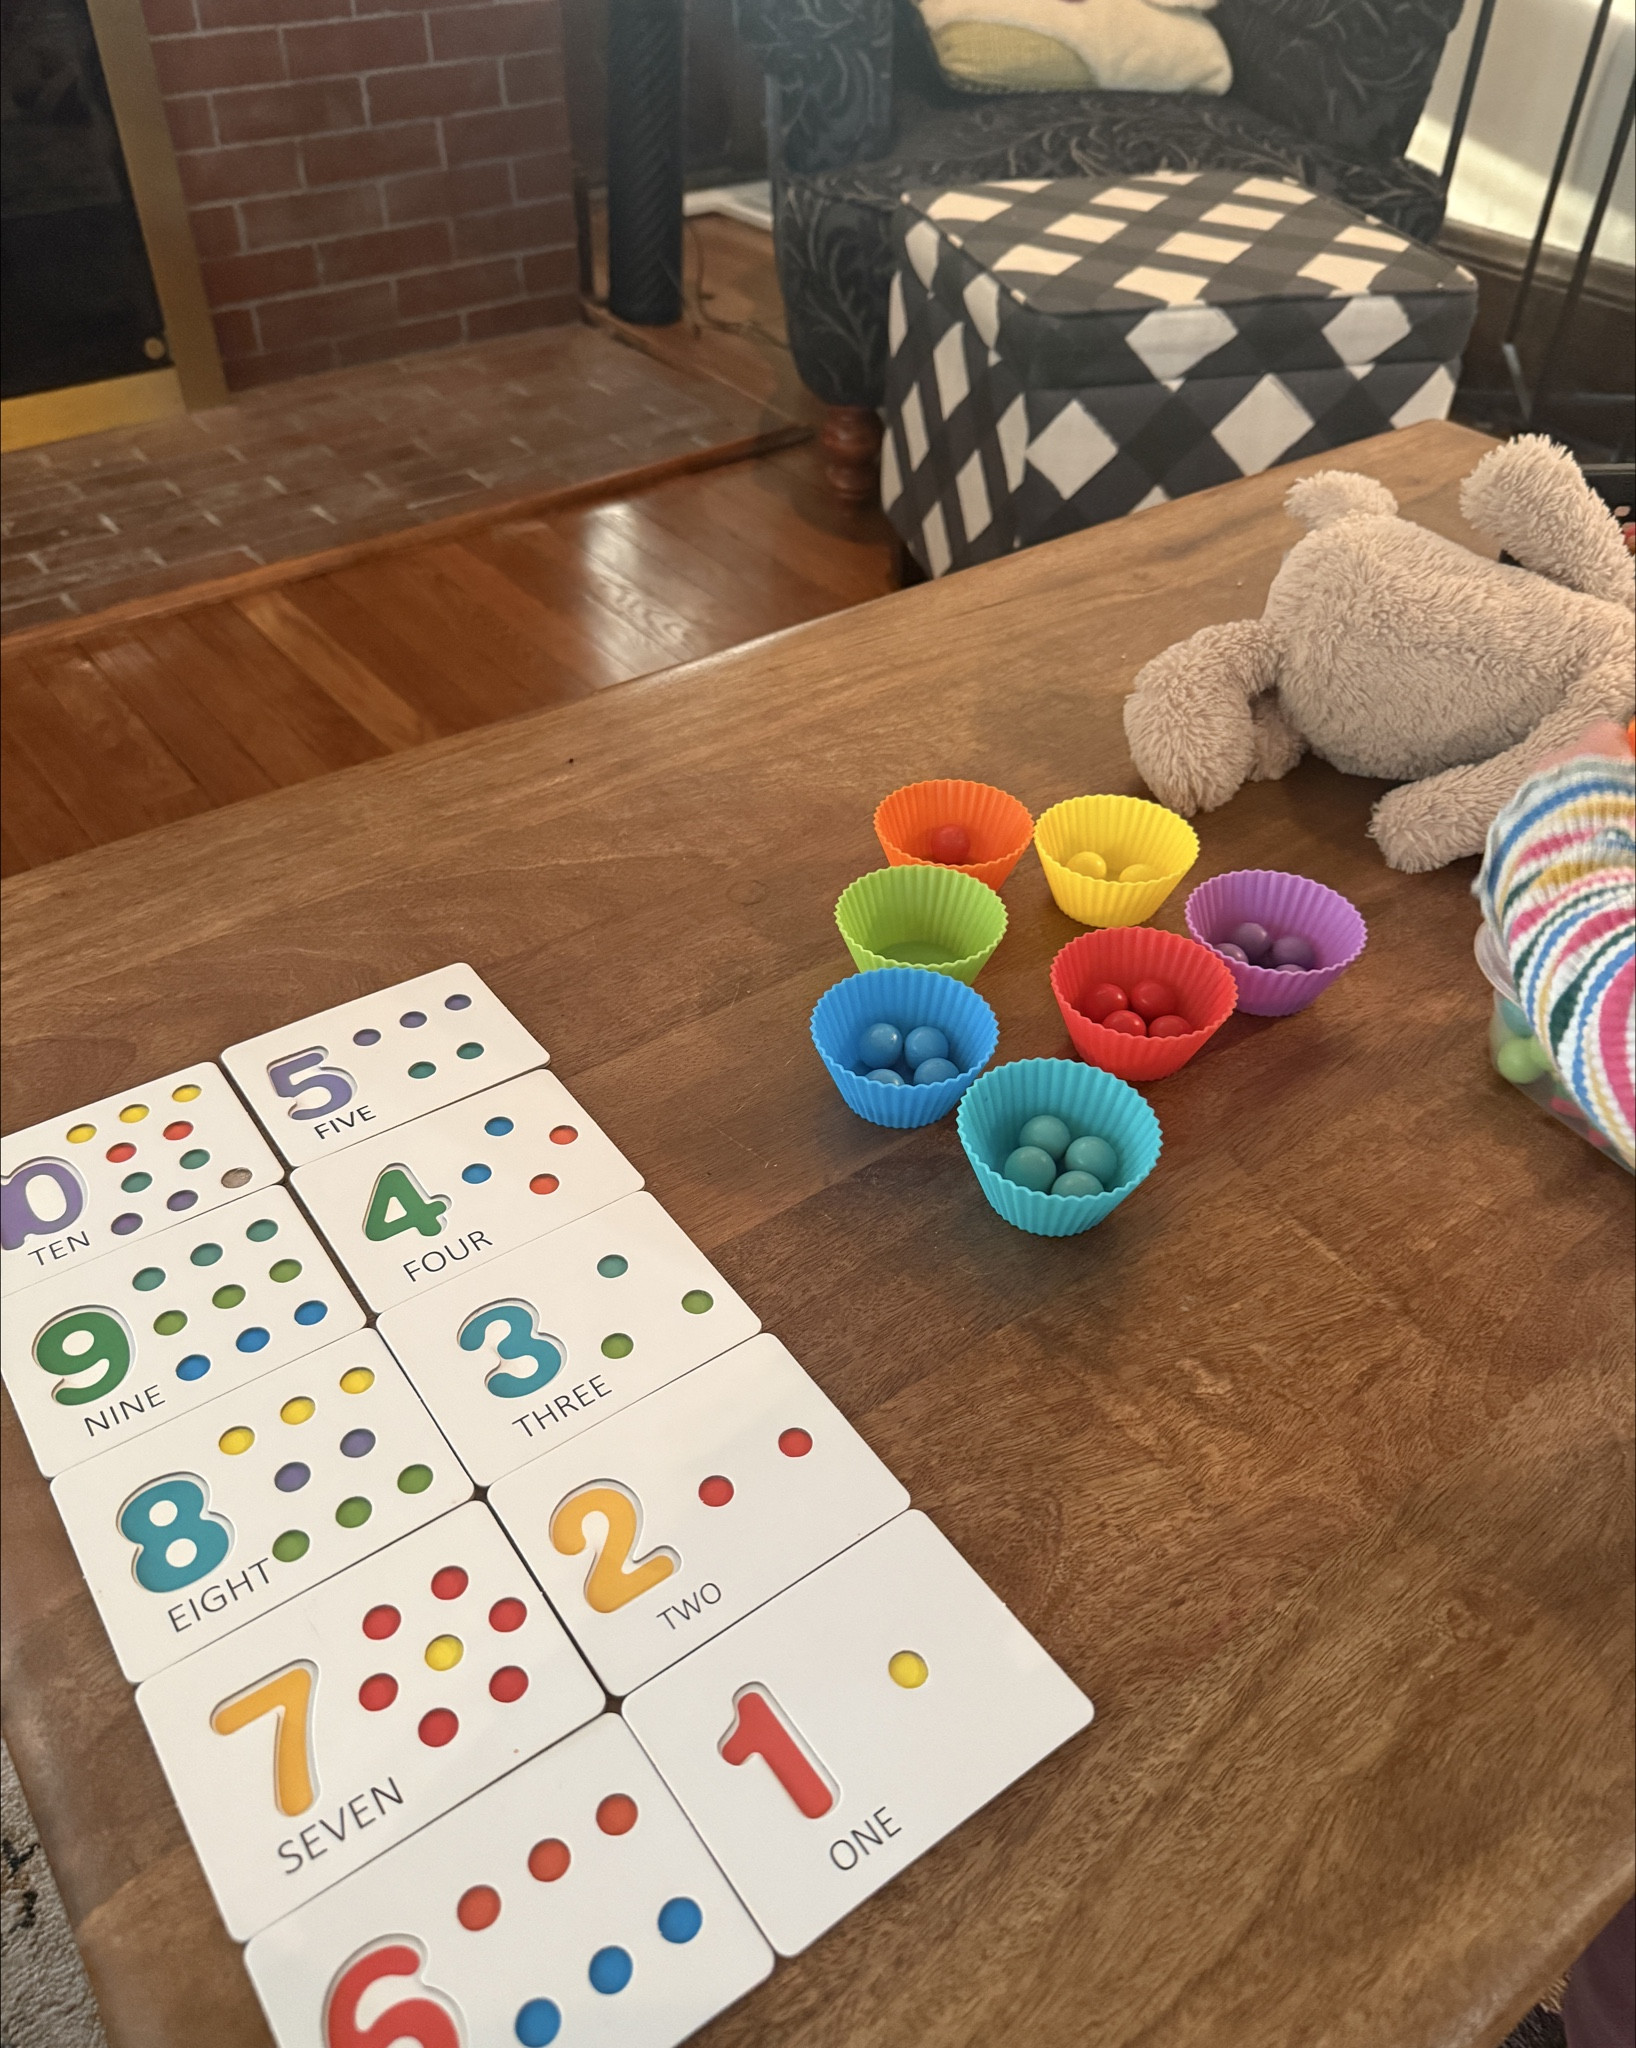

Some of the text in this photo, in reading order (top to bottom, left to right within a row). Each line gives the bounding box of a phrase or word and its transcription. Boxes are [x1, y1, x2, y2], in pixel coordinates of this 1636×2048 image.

[267, 1046, 358, 1121] 5
[313, 1105, 377, 1140] FIVE
[362, 1162, 452, 1241] 4
[27, 1230, 90, 1266] TEN
[402, 1229, 494, 1282] FOUR
[32, 1304, 138, 1406] 9
[456, 1298, 568, 1398] 3
[83, 1383, 166, 1437] NINE
[511, 1374, 612, 1438] THREE
[116, 1471, 237, 1594] 8
[548, 1478, 682, 1614] 2
[166, 1557, 273, 1633] EIGHT
[656, 1582, 722, 1630] TWO
[210, 1658, 320, 1818] 7
[717, 1681, 841, 1820] 1
[277, 1776, 404, 1875] SEVEN
[829, 1806, 902, 1871] ONE
[322, 1933, 466, 2048] 6
